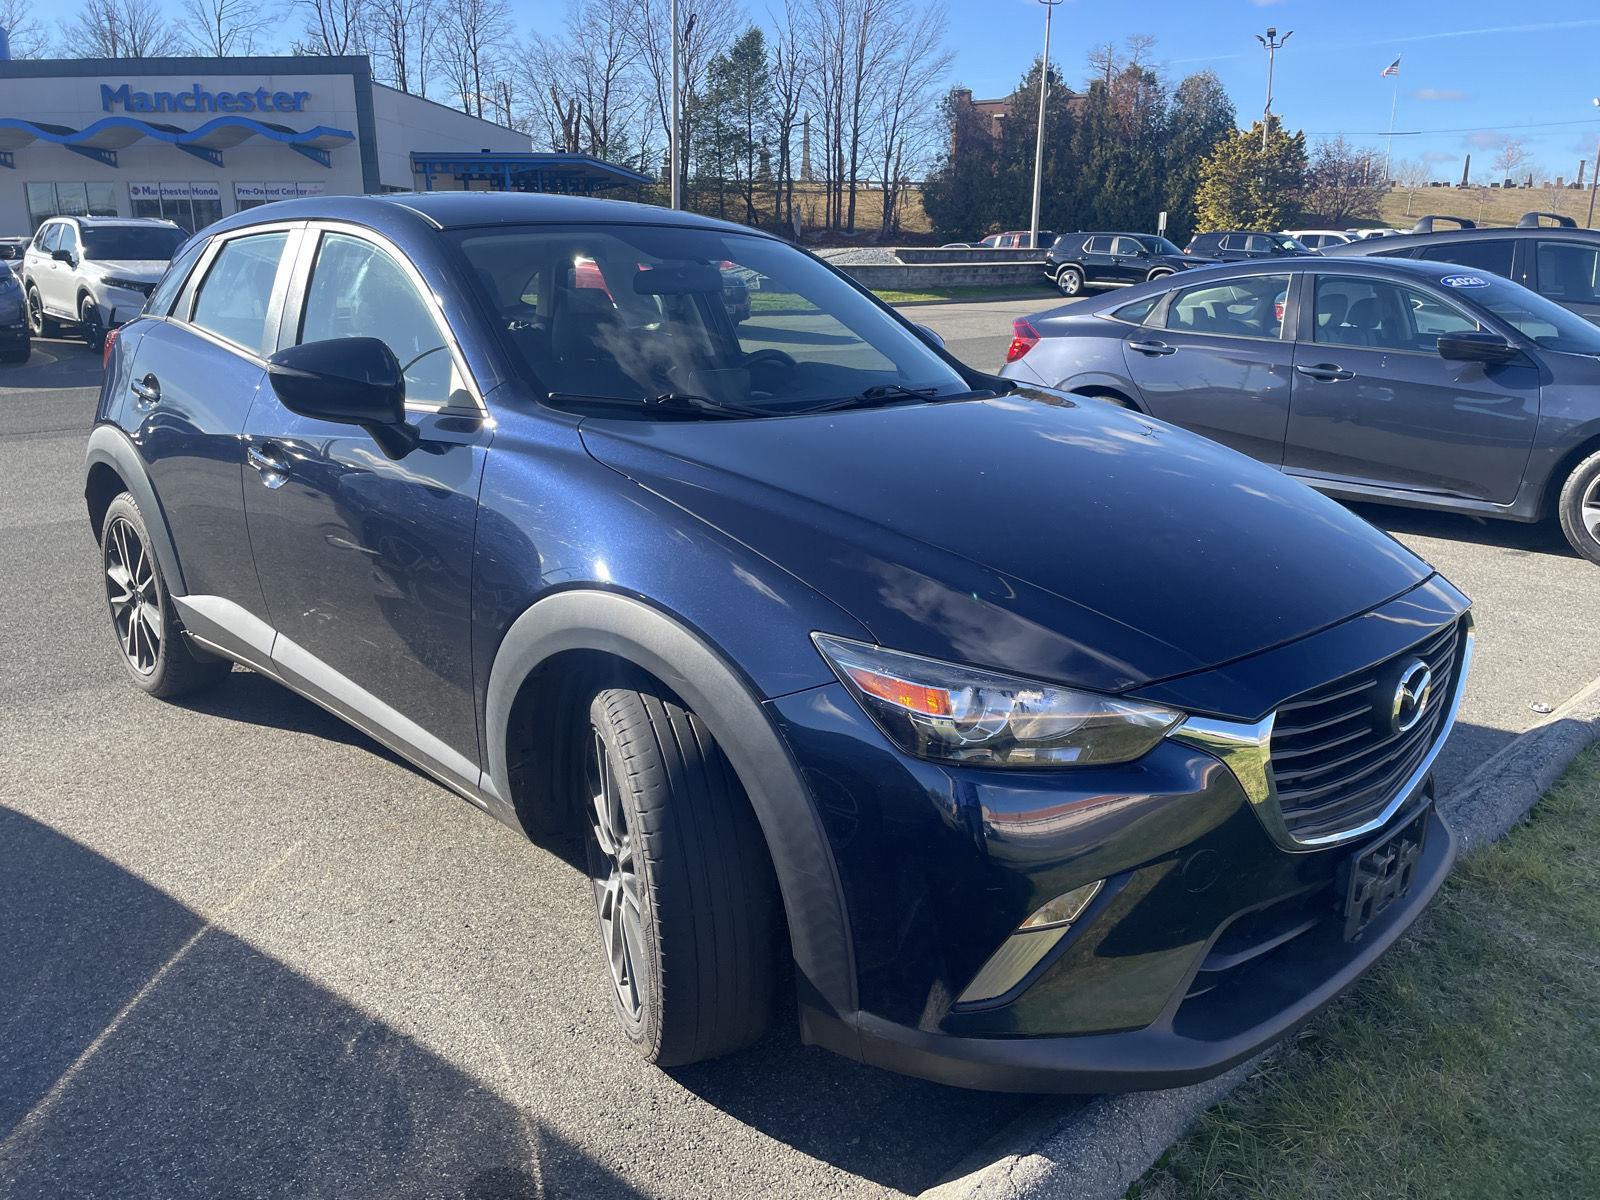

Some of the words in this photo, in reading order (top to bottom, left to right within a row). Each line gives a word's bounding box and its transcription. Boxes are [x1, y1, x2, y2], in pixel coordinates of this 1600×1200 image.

[100, 83, 311, 112] Manchester
[192, 187, 219, 195] Honda
[237, 187, 280, 195] Pre-Owned
[281, 187, 307, 195] Center
[1447, 277, 1485, 286] 2020
